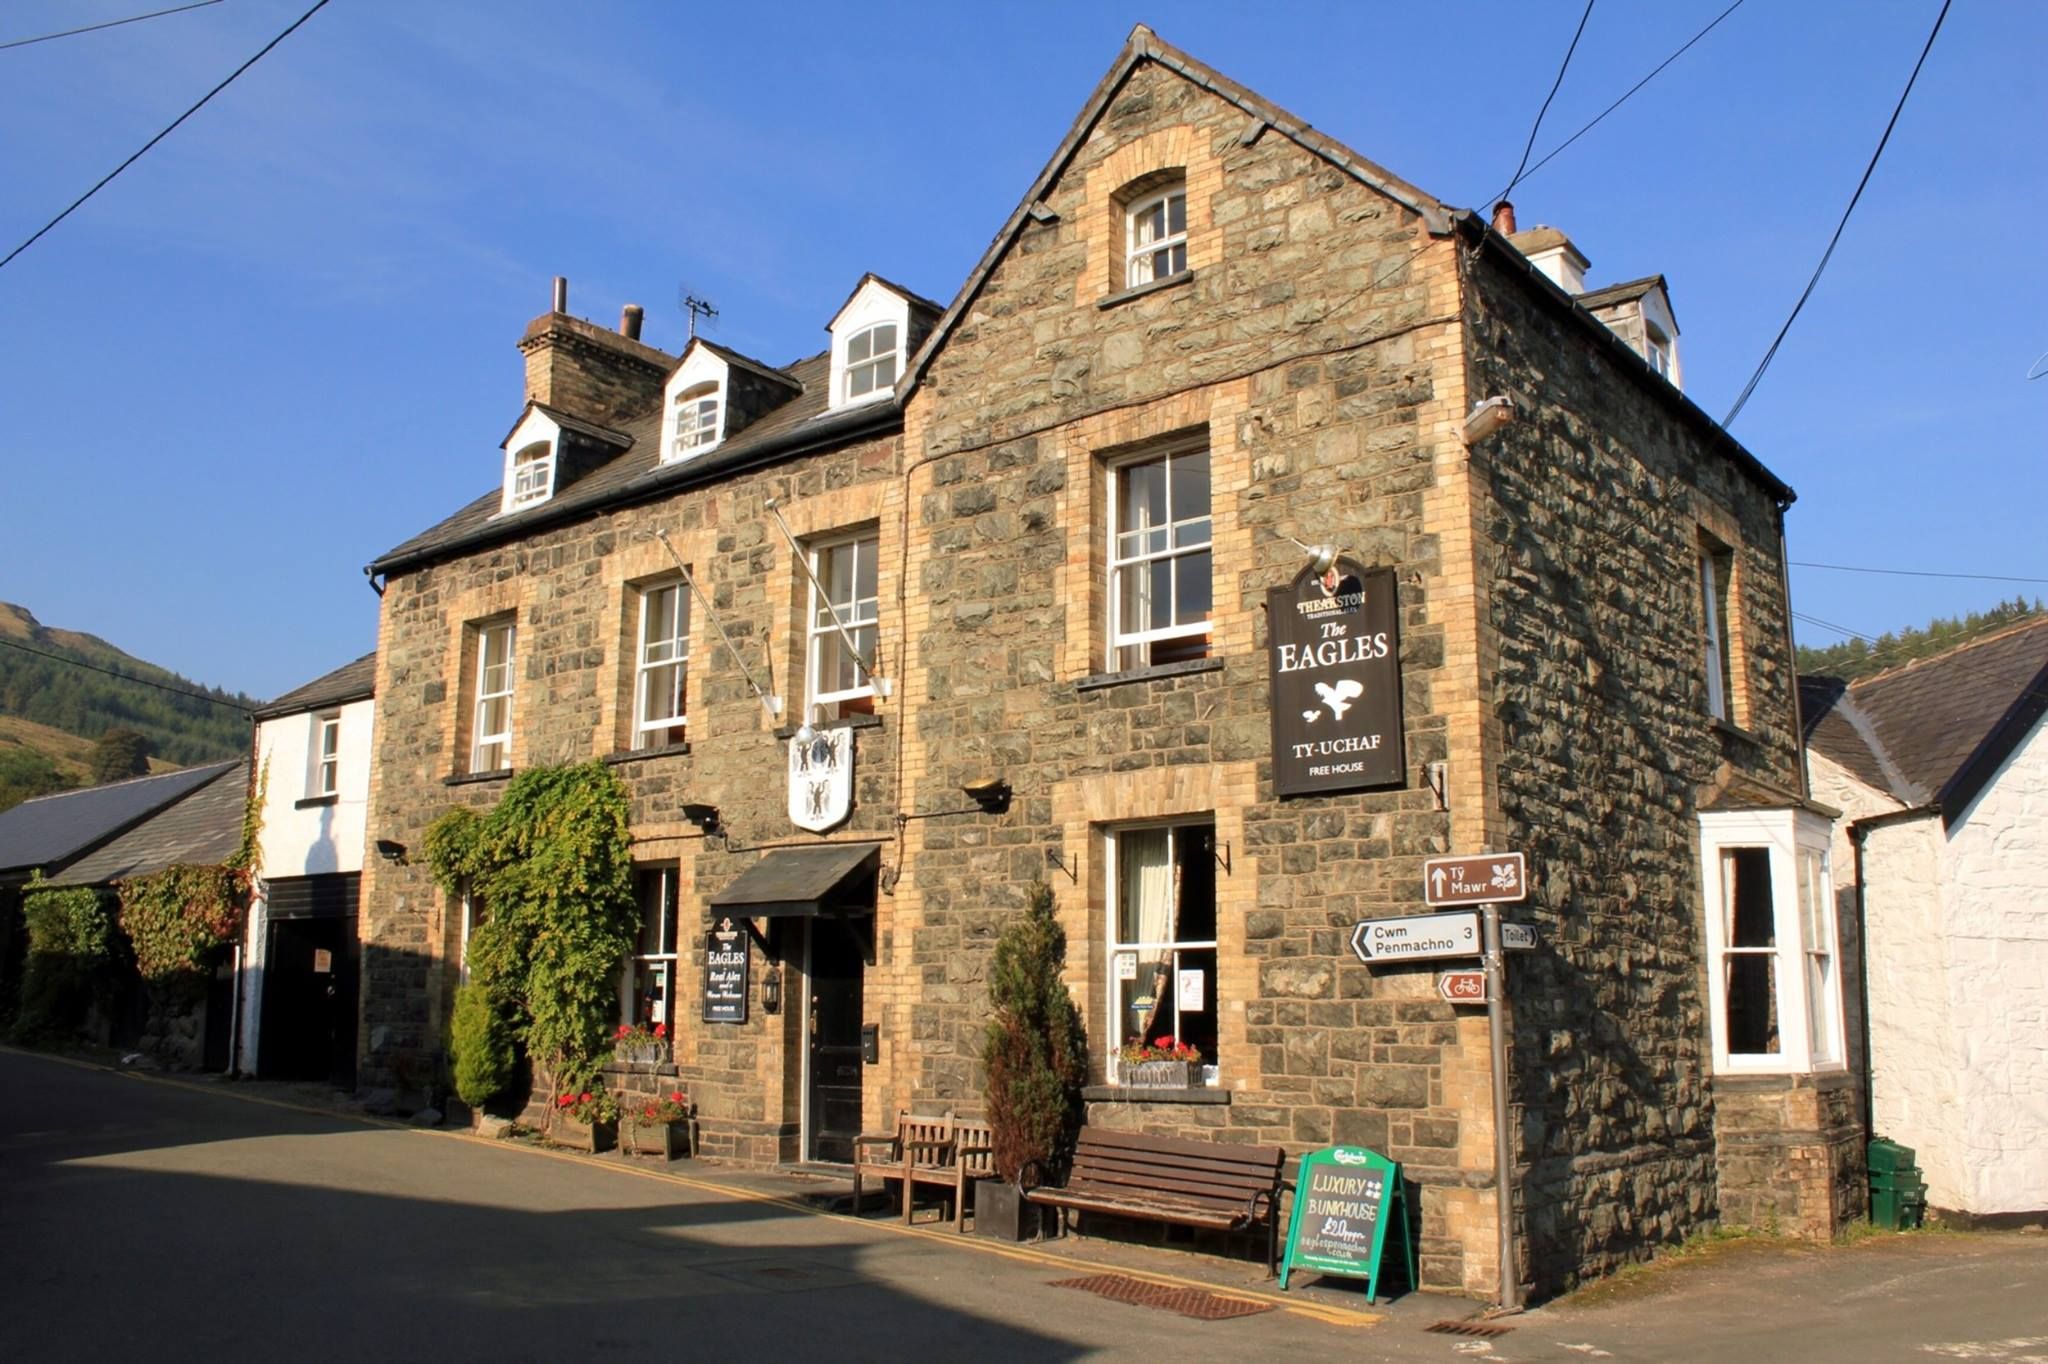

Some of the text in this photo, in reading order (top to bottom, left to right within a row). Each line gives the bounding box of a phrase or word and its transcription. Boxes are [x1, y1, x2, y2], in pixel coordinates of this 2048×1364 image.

[1297, 592, 1365, 614] THEAKSTON
[1321, 622, 1347, 638] The
[1278, 632, 1389, 672] EAGLES
[1293, 735, 1381, 758] TY-UCHAF
[1309, 762, 1364, 776] FREE HOUSE
[1451, 881, 1487, 894] Mawr
[1375, 926, 1407, 939] Cwm
[1464, 927, 1473, 939] 3
[1376, 939, 1454, 954] Penmachno
[708, 951, 745, 965] EAGLES
[710, 971, 741, 981] Real Ales
[1312, 1174, 1367, 1197] LUXURY
[1308, 1199, 1378, 1222] BUNKHOUSE
